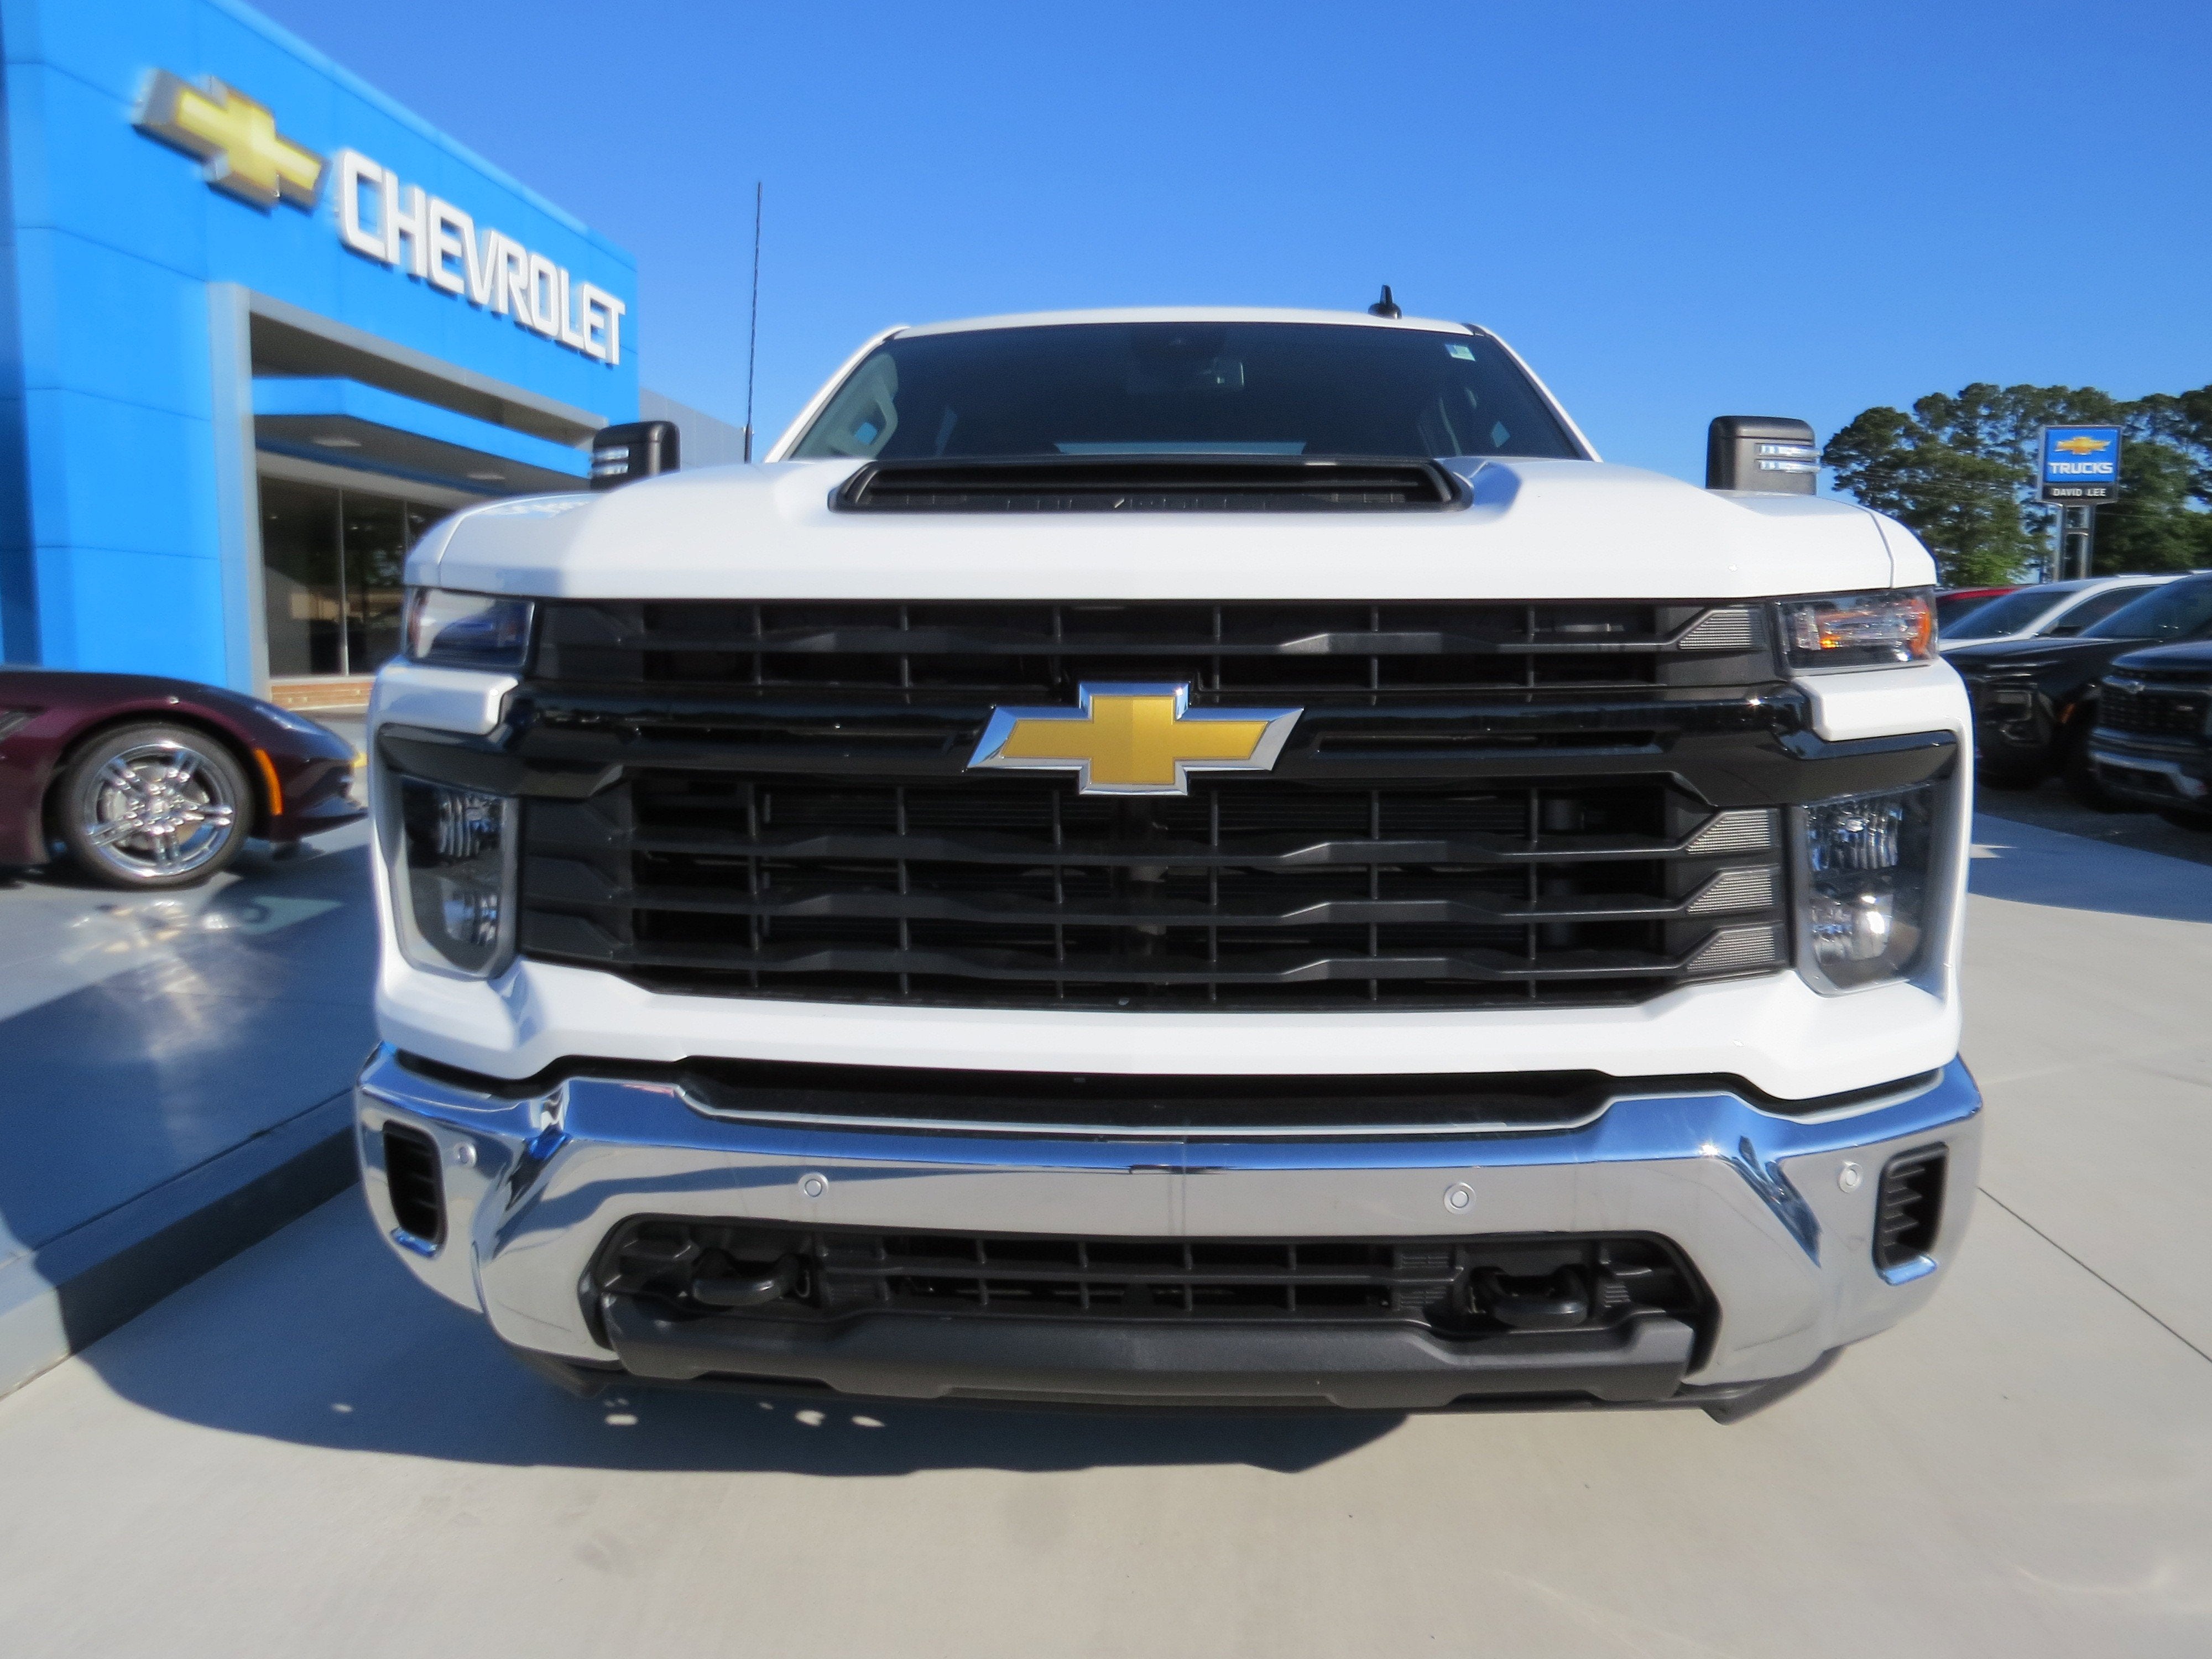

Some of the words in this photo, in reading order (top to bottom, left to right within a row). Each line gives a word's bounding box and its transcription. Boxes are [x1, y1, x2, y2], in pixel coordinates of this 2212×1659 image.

[337, 148, 625, 366] CHEVROLET
[2049, 462, 2113, 474] TRUCKS
[2052, 488, 2083, 497] DAVID
[2086, 488, 2106, 497] LEE
